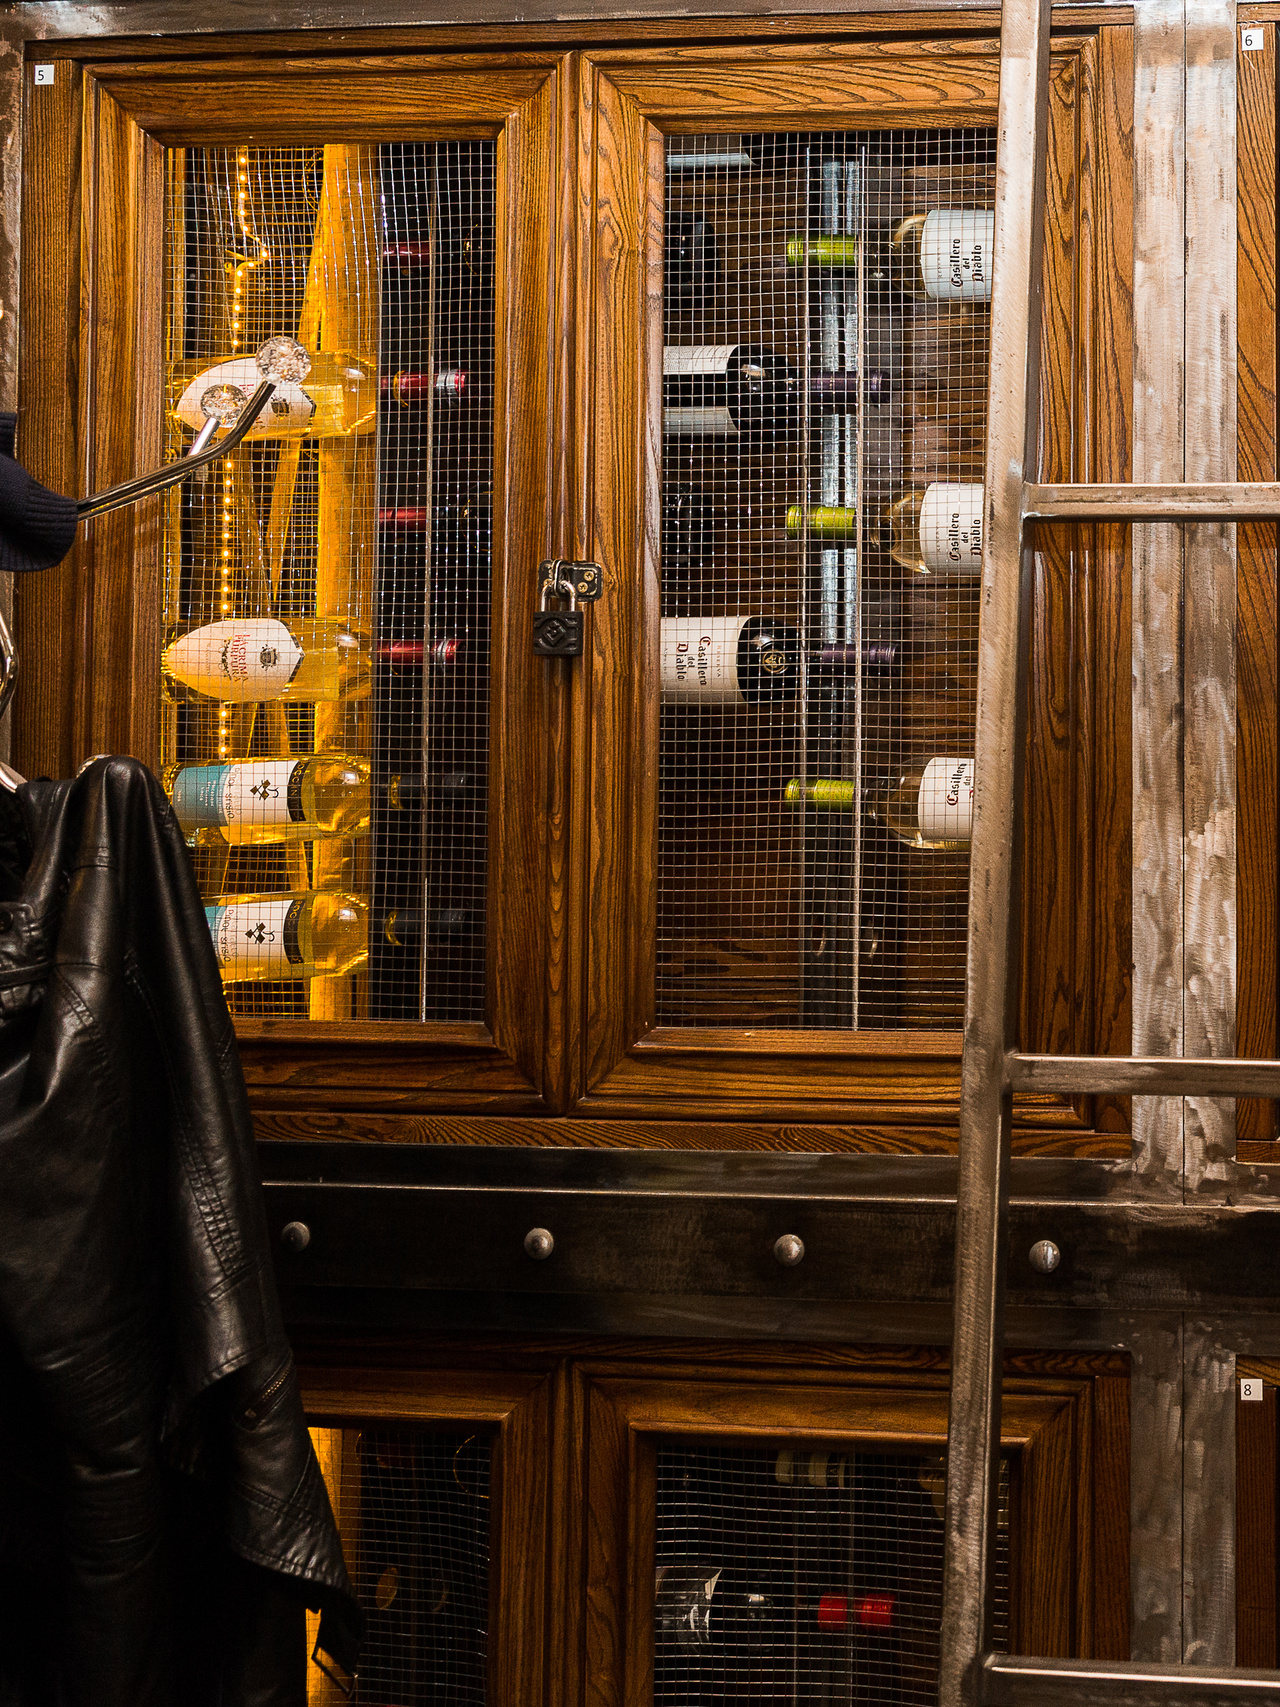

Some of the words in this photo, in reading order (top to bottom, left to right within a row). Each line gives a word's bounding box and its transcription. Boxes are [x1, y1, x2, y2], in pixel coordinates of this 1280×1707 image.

[1245, 35, 1252, 46] 6
[38, 70, 44, 81] 5
[950, 239, 963, 287] Casillero
[971, 245, 984, 283] Diablo
[949, 513, 961, 561] Casillero
[970, 519, 981, 556] Diablo
[230, 634, 242, 683] PURPURA
[238, 634, 250, 683] LACRIMA
[676, 643, 688, 680] Diablo
[698, 636, 711, 686] Casillero
[963, 776, 971, 786] del
[1244, 1384, 1251, 1396] 8
